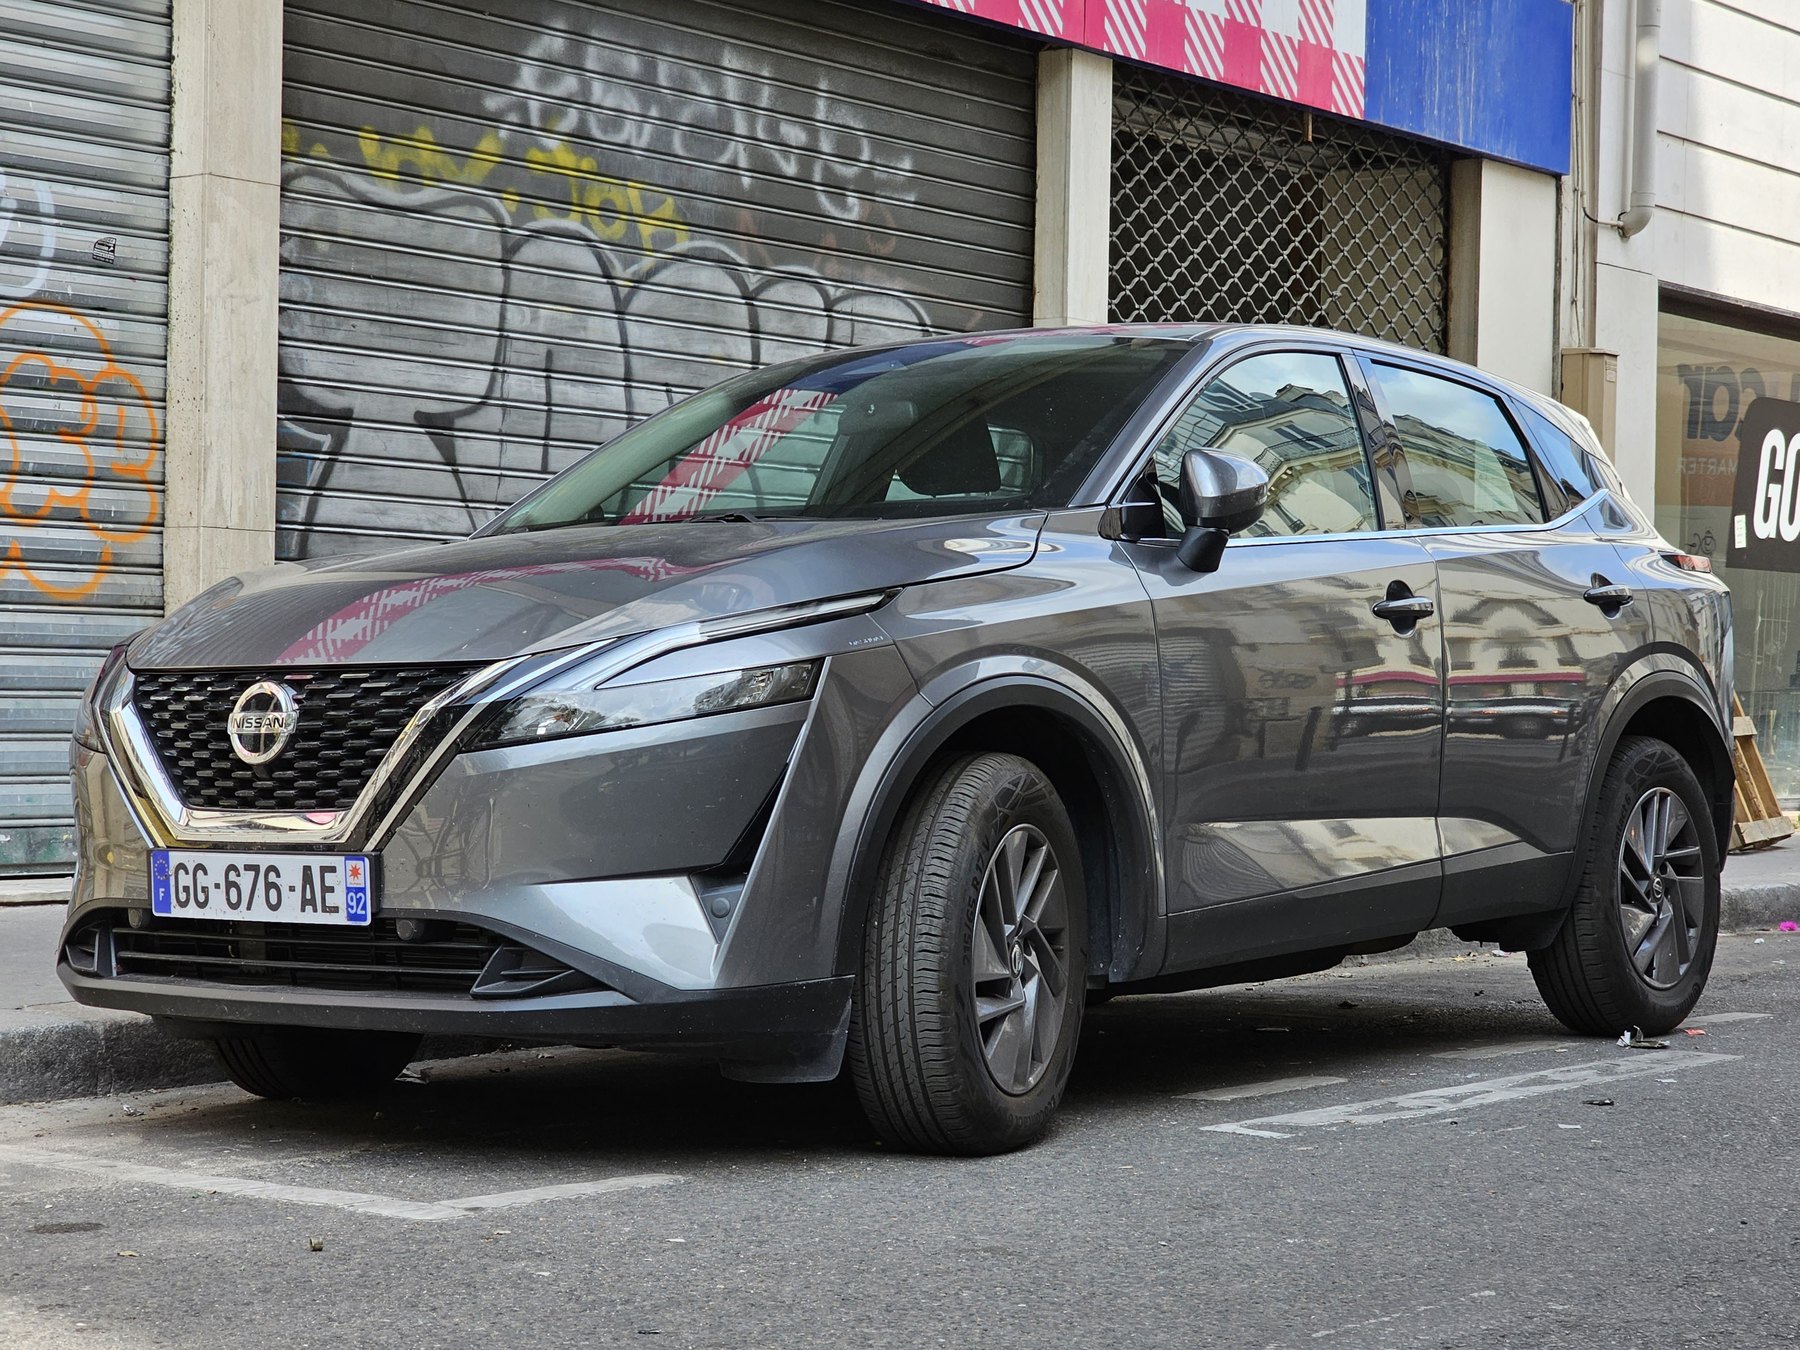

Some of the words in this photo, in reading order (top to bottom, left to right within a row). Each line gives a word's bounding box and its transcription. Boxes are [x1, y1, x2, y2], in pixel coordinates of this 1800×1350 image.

[232, 717, 285, 729] NISSAN
[158, 887, 166, 900] F
[173, 862, 340, 914] GG-676-AE
[347, 892, 366, 915] 92
